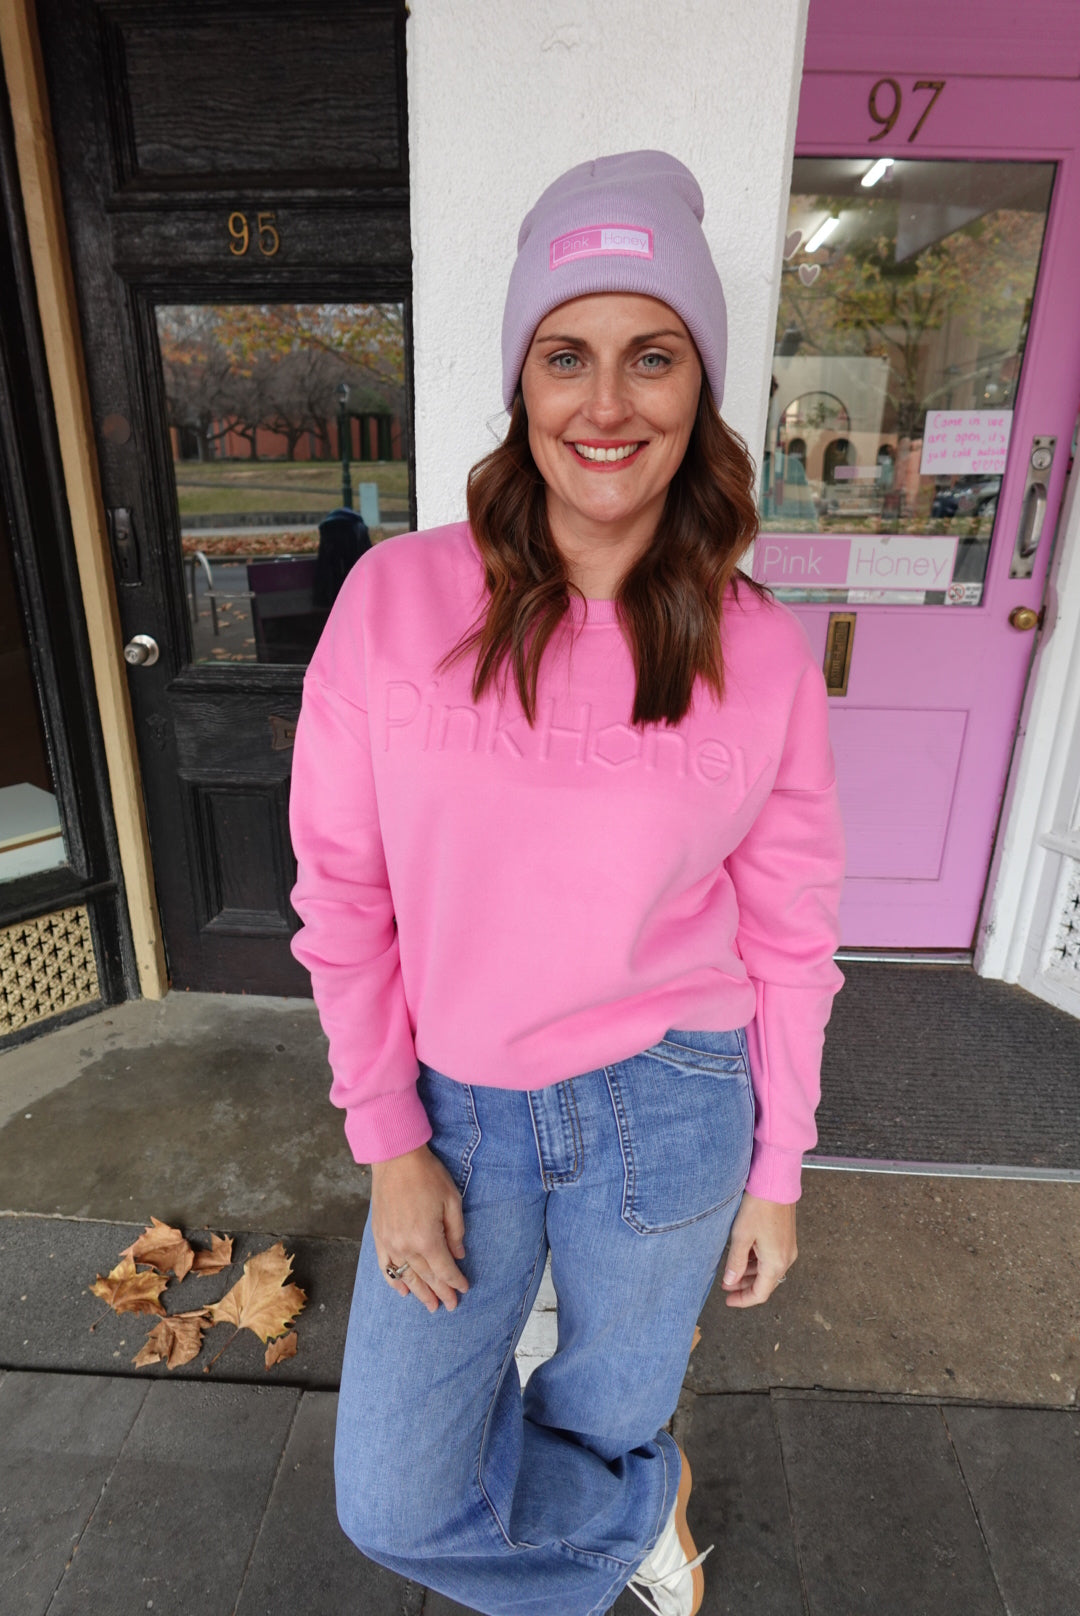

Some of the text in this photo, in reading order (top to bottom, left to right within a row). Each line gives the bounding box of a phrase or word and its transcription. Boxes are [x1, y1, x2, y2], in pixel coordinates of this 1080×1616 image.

[867, 78, 946, 143] 97
[228, 211, 280, 256] 95
[562, 231, 647, 254] Pink Honey
[934, 413, 1004, 429] Come in we
[927, 433, 948, 445] are
[762, 545, 949, 583] Pink Honey
